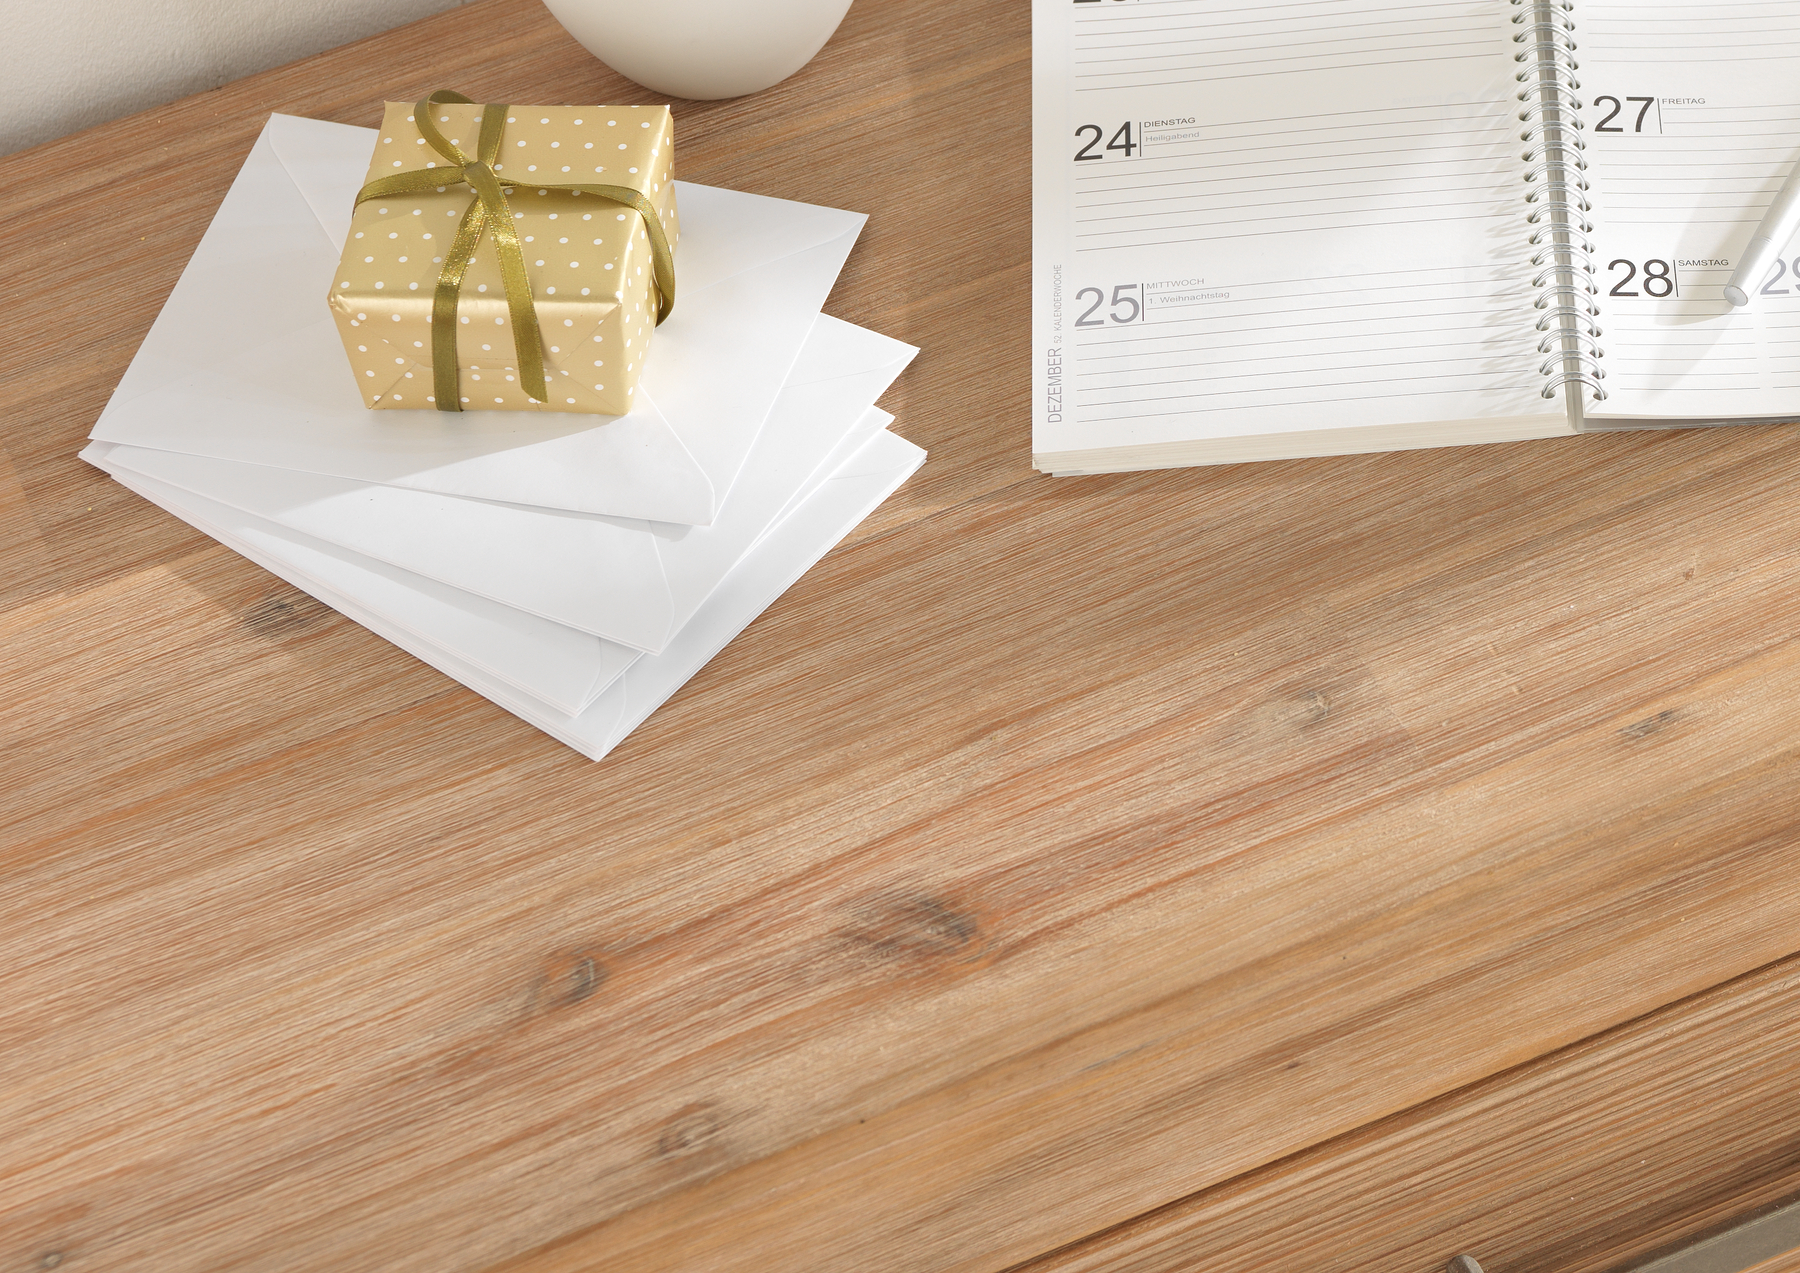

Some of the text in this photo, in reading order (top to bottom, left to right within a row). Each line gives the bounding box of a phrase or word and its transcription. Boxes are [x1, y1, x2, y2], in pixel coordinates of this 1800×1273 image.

[1144, 117, 1196, 128] DIENSTAG
[1593, 95, 1655, 133] 27
[1073, 121, 1137, 161] 24
[1145, 131, 1200, 143] Heiligabend
[1607, 258, 1674, 298] 28
[1678, 259, 1729, 267] SAMSTAG
[1053, 264, 1062, 331] KALENDERWOCHE
[1146, 278, 1205, 289] MITTWOCH
[1160, 291, 1230, 304] Weihnachtstag
[1074, 283, 1140, 327] 25
[1048, 347, 1062, 423] DEZEMBER
